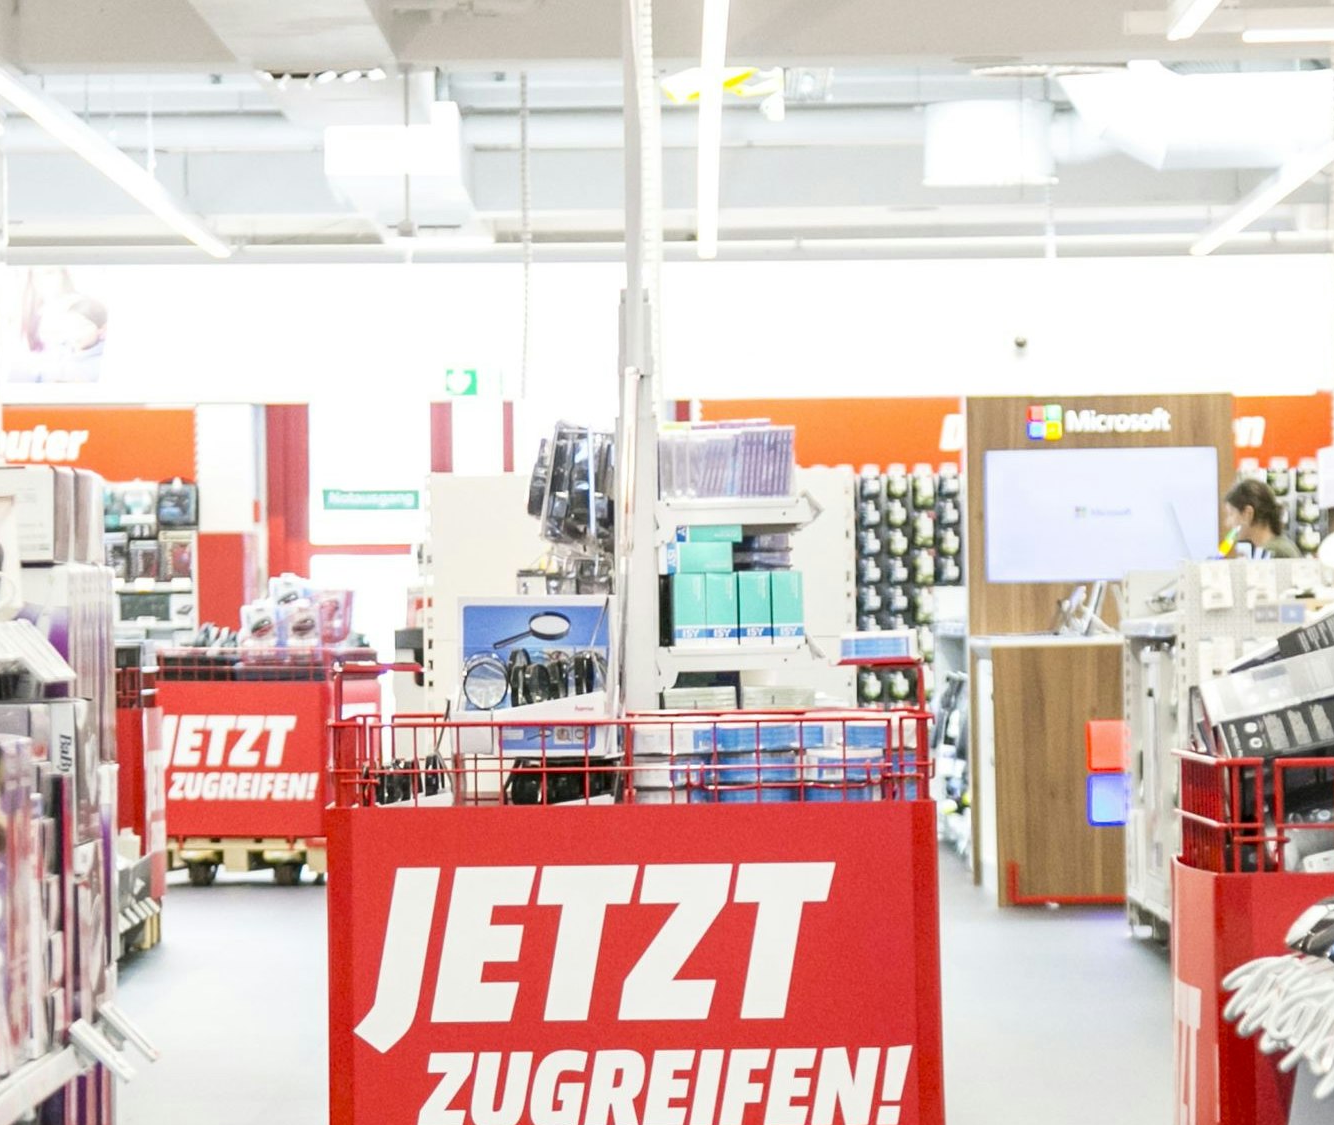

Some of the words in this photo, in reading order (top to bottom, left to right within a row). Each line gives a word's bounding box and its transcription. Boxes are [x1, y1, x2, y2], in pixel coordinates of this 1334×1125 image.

[1065, 407, 1172, 433] Microsoft
[713, 628, 732, 638] ISY
[747, 627, 764, 637] ISY
[163, 715, 297, 770] JETZT
[168, 772, 320, 800] ZUGREIFEN!
[353, 861, 836, 1054] JETZT
